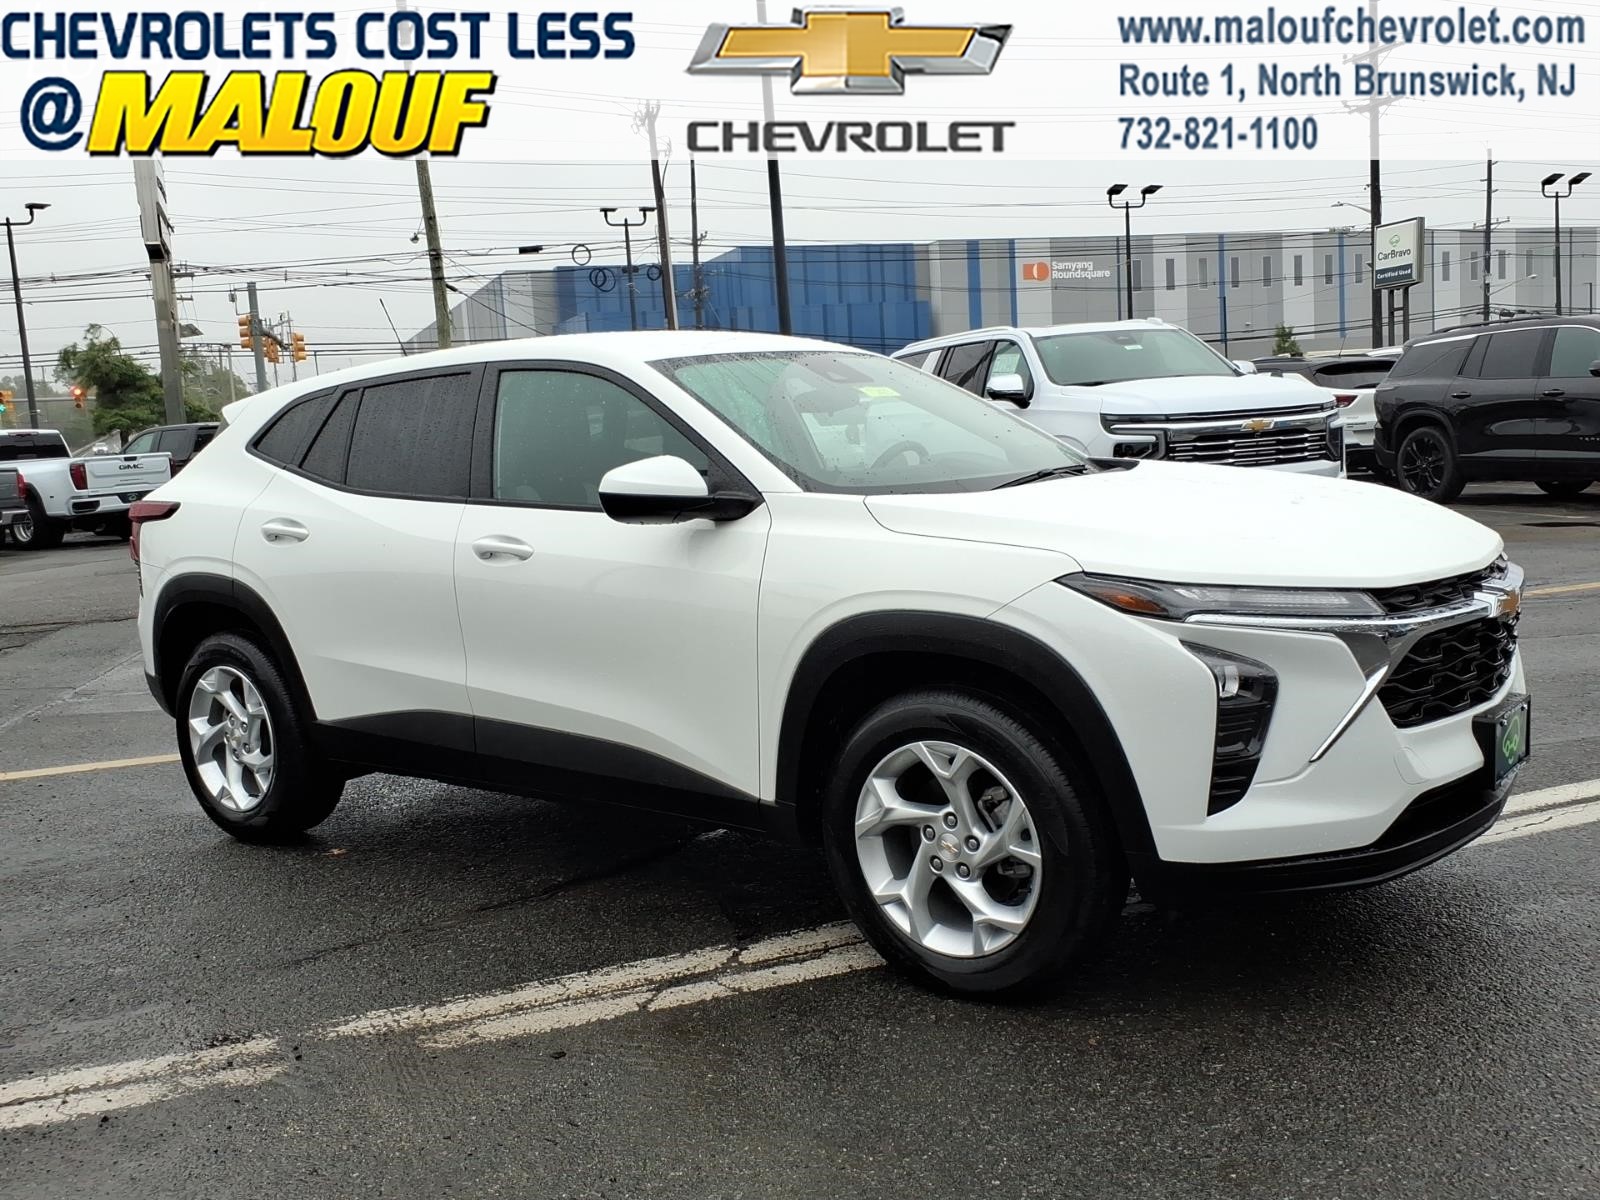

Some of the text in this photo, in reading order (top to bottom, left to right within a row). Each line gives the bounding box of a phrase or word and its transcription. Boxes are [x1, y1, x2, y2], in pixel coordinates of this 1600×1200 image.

[1377, 248, 1411, 261] CarBravo
[1052, 261, 1094, 271] Samyang
[1052, 270, 1111, 279] Roundsquare
